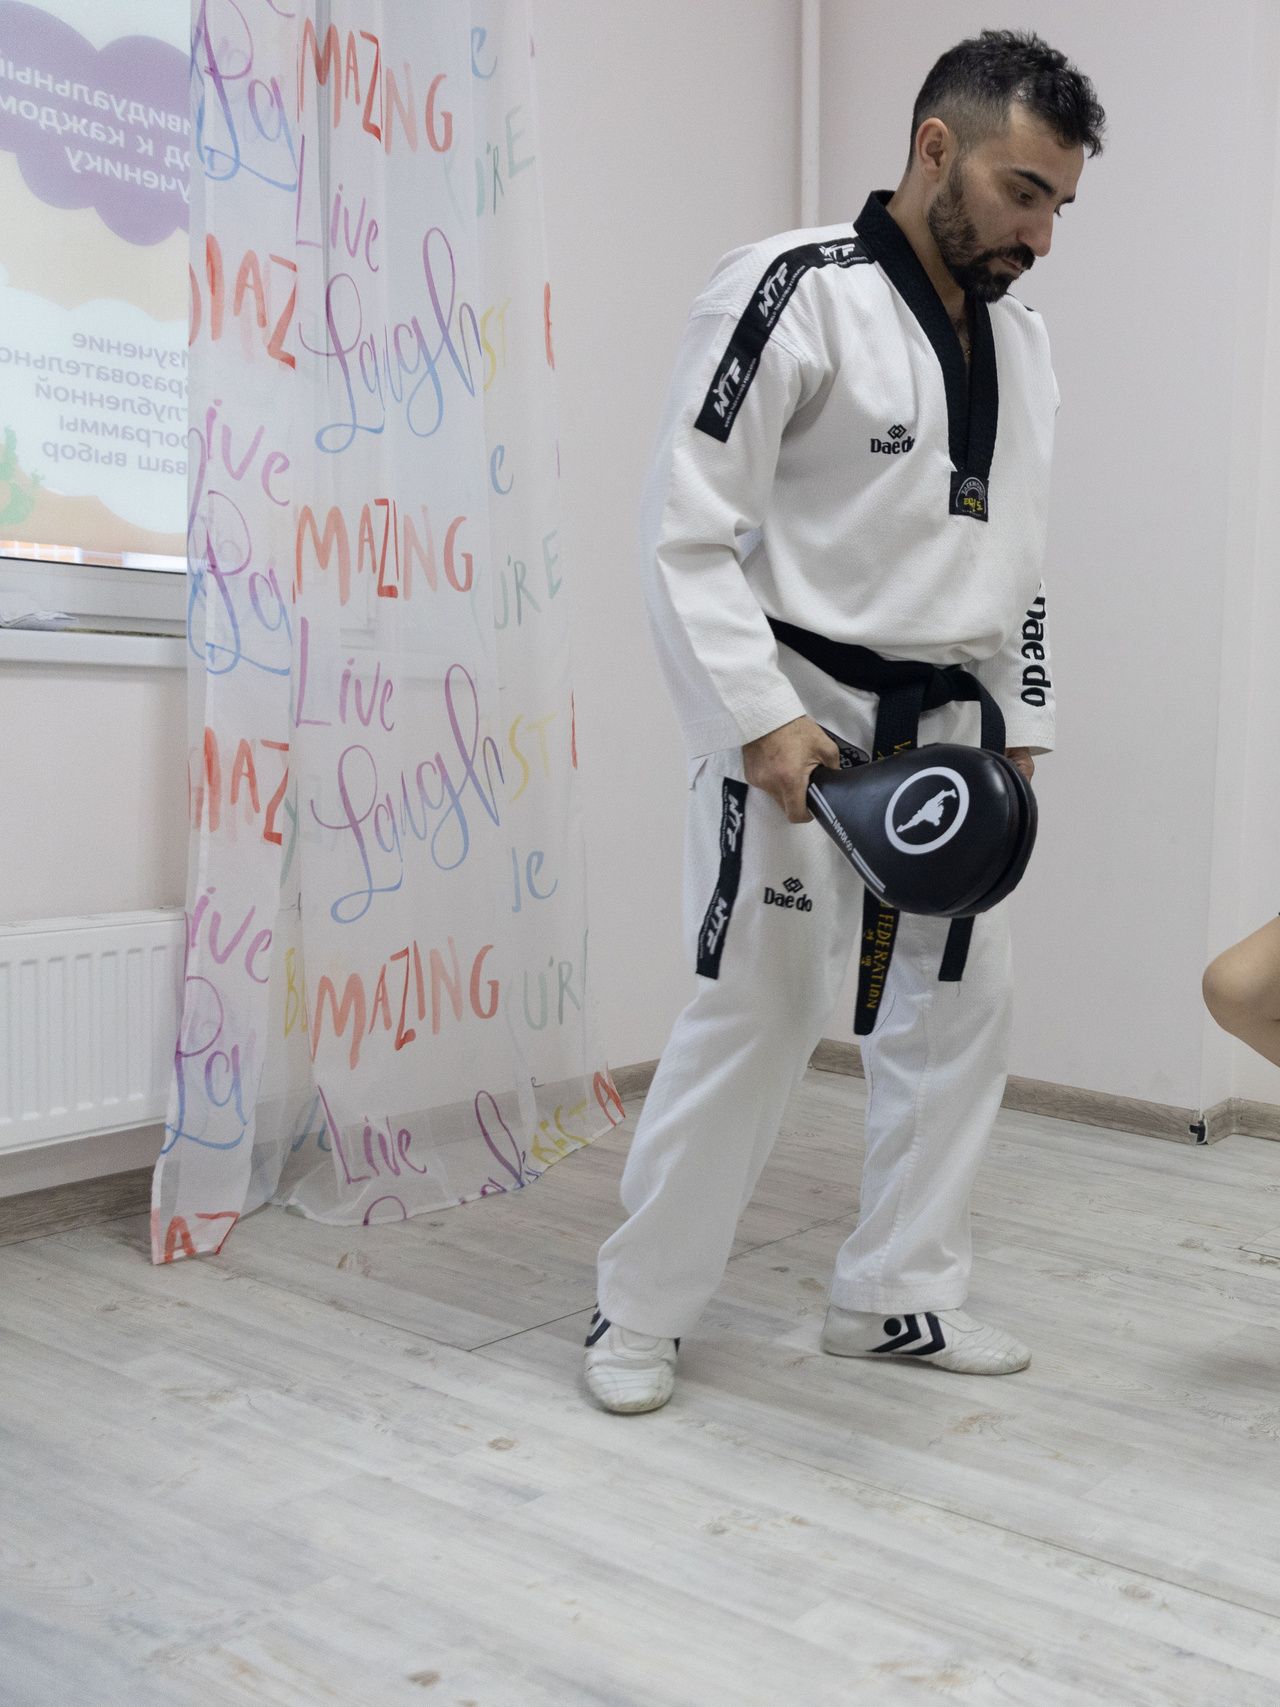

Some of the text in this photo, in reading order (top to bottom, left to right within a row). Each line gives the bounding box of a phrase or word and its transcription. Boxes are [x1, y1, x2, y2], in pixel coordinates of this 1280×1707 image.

[296, 133, 380, 273] Live
[299, 227, 483, 454] Laugh
[712, 357, 741, 418] WTF
[870, 436, 915, 455] Daed
[296, 616, 394, 732] Live
[310, 664, 505, 924] Laugh
[763, 887, 812, 912] Daedo
[866, 914, 894, 1008] FEDERATION
[318, 1084, 427, 1184] Live
